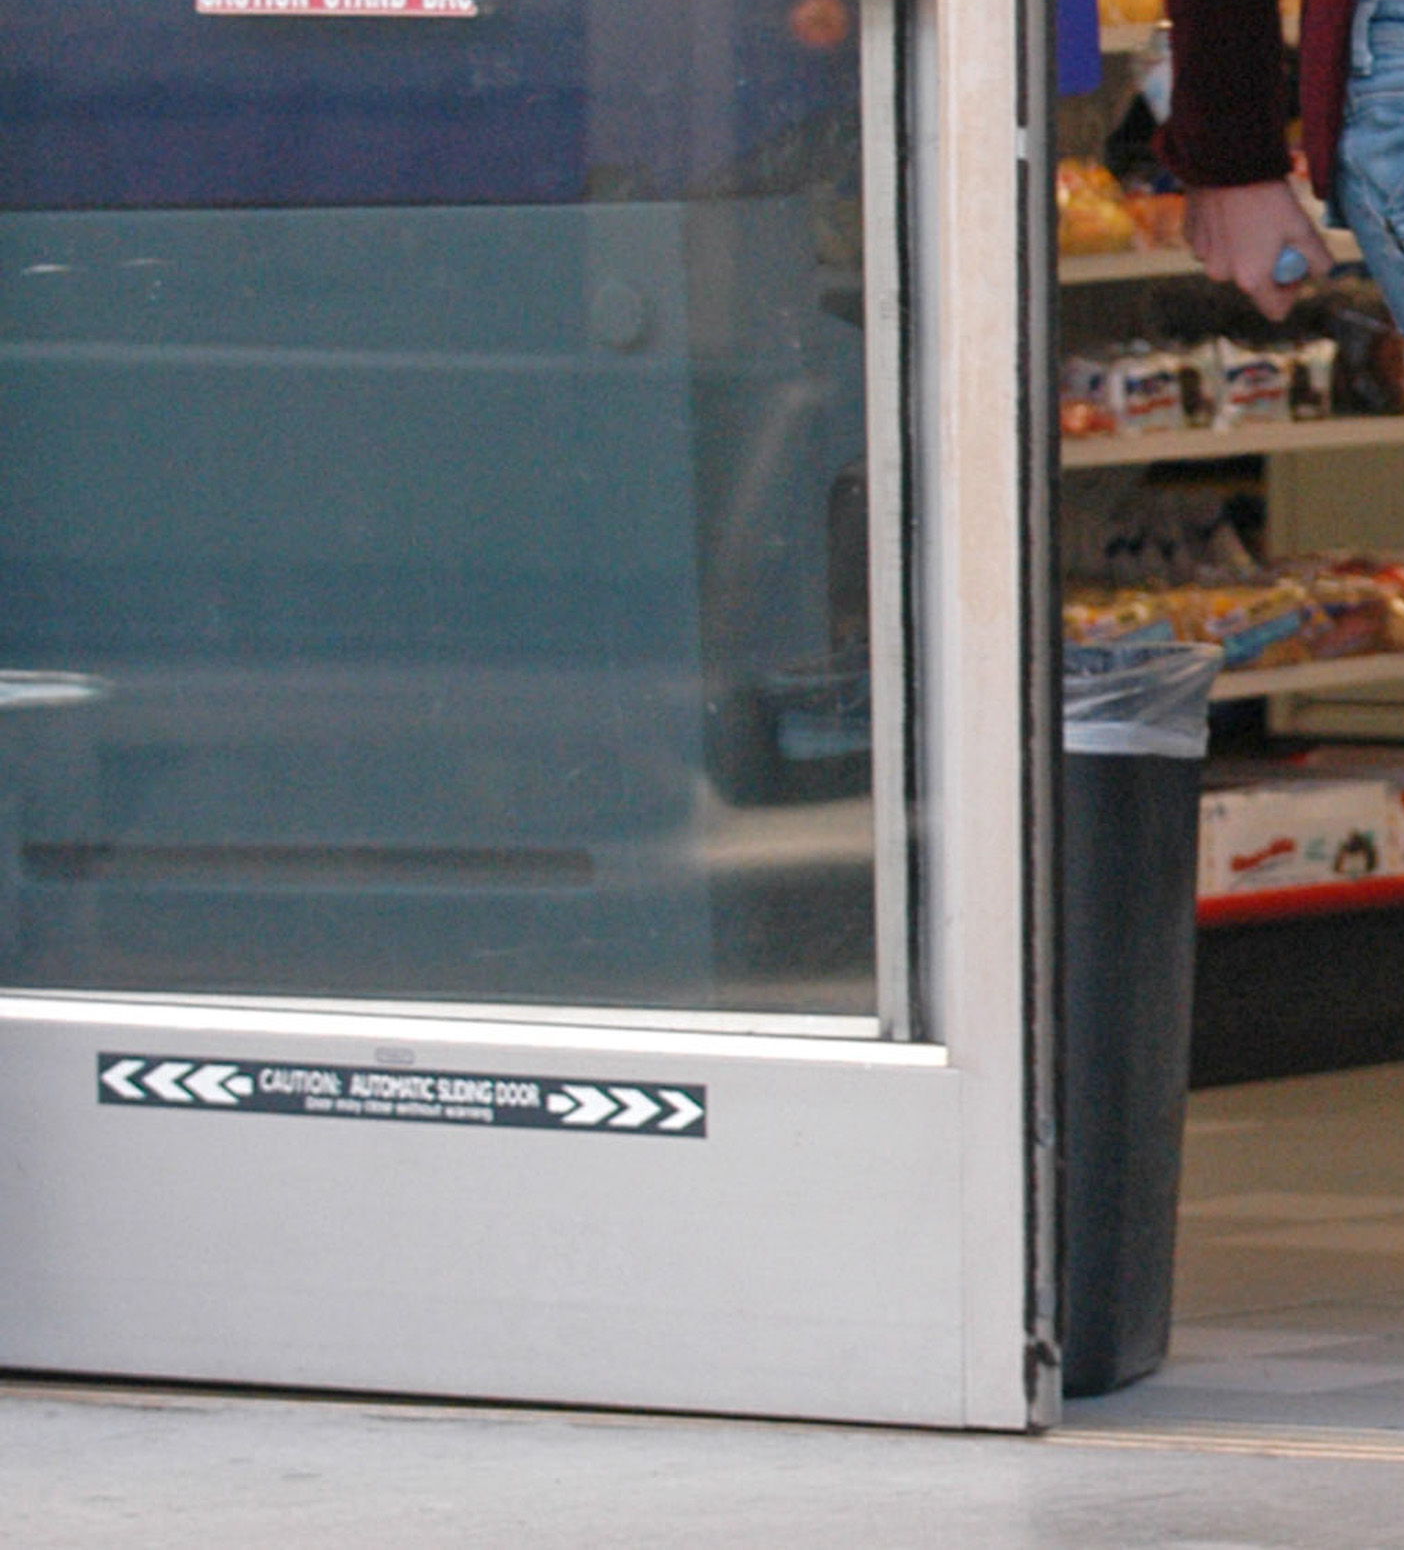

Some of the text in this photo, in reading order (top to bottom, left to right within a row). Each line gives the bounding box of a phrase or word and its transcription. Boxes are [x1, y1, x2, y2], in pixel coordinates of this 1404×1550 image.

[348, 1073, 435, 1101] AUTOMATIC
[437, 1079, 493, 1105] SLIDING
[495, 1082, 540, 1107] DOOR
